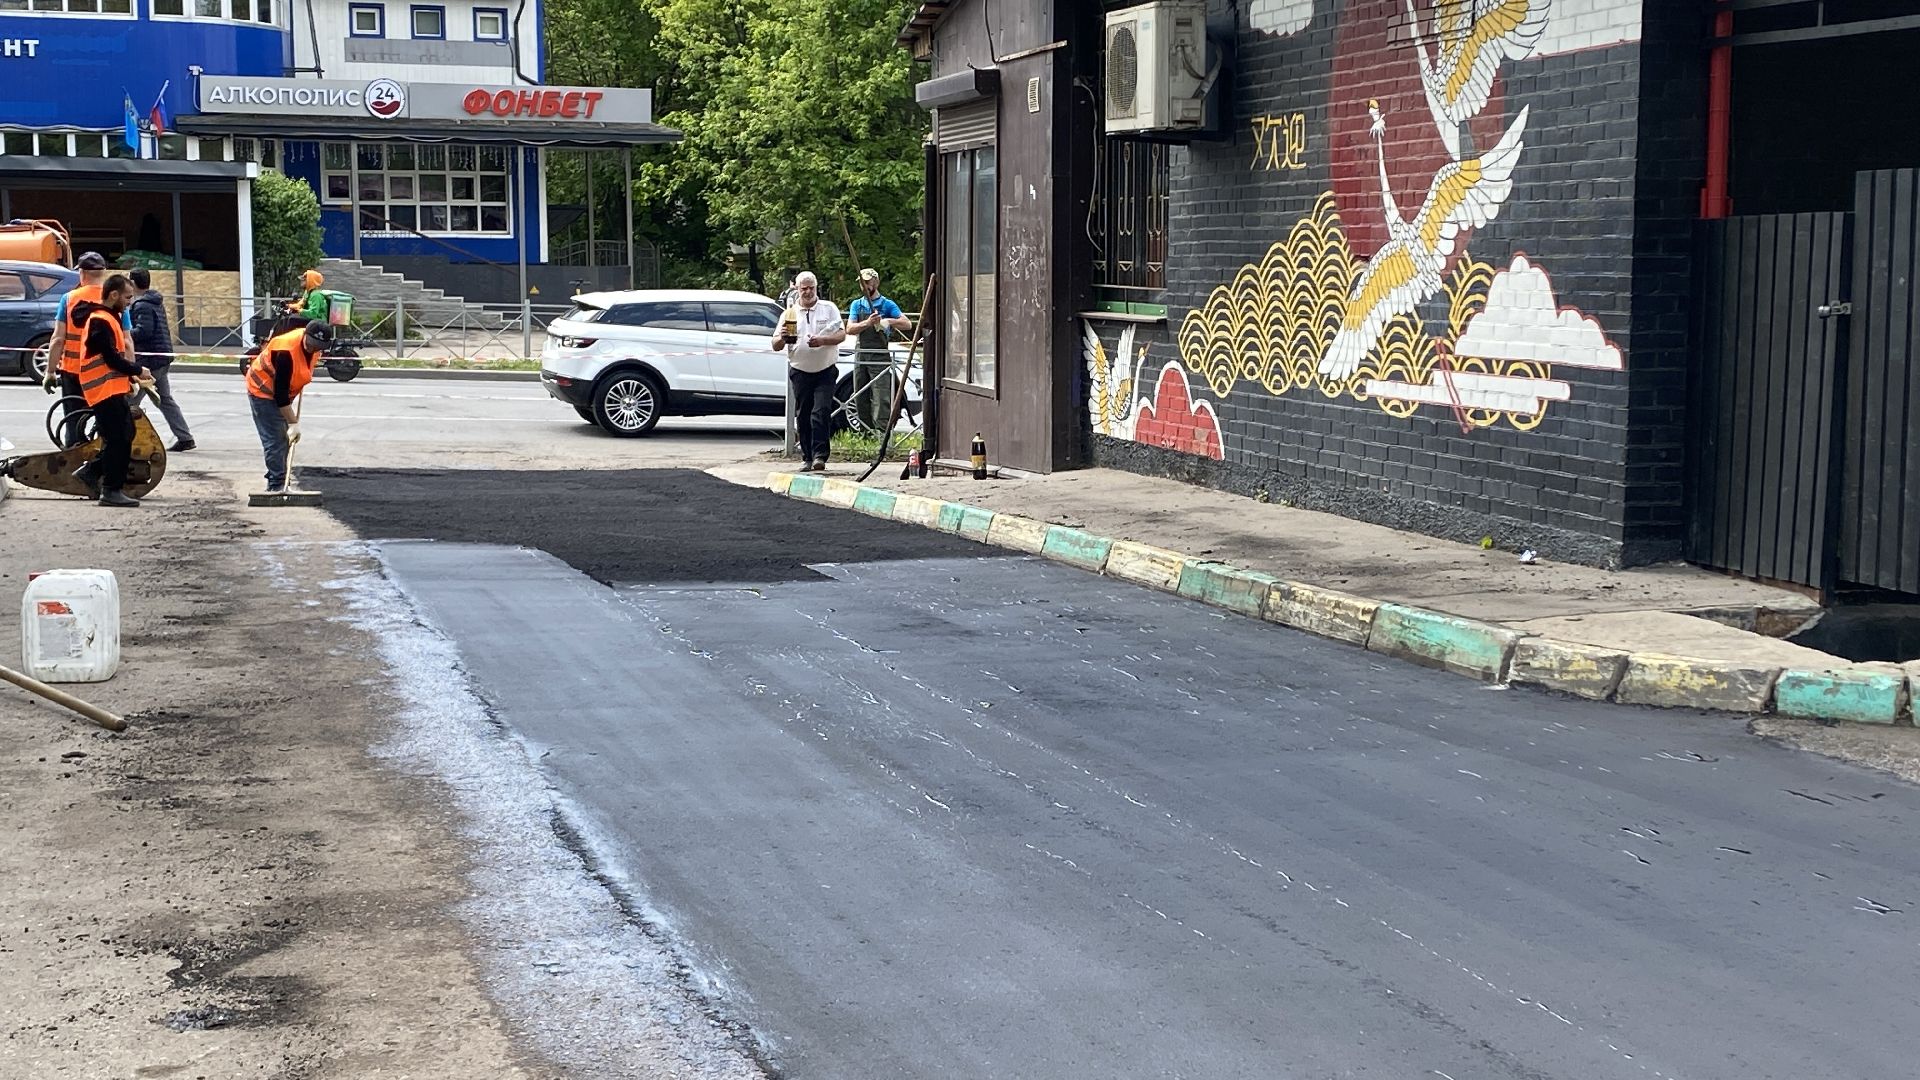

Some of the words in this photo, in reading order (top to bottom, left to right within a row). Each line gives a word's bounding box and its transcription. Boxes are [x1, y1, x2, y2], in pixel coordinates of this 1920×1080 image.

[0, 39, 39, 57] НТ
[209, 86, 361, 106] АЛКОПОЛИС
[375, 87, 395, 100] 24
[463, 89, 603, 119] ФОНБЕТ
[1250, 113, 1306, 170] 欢迎
